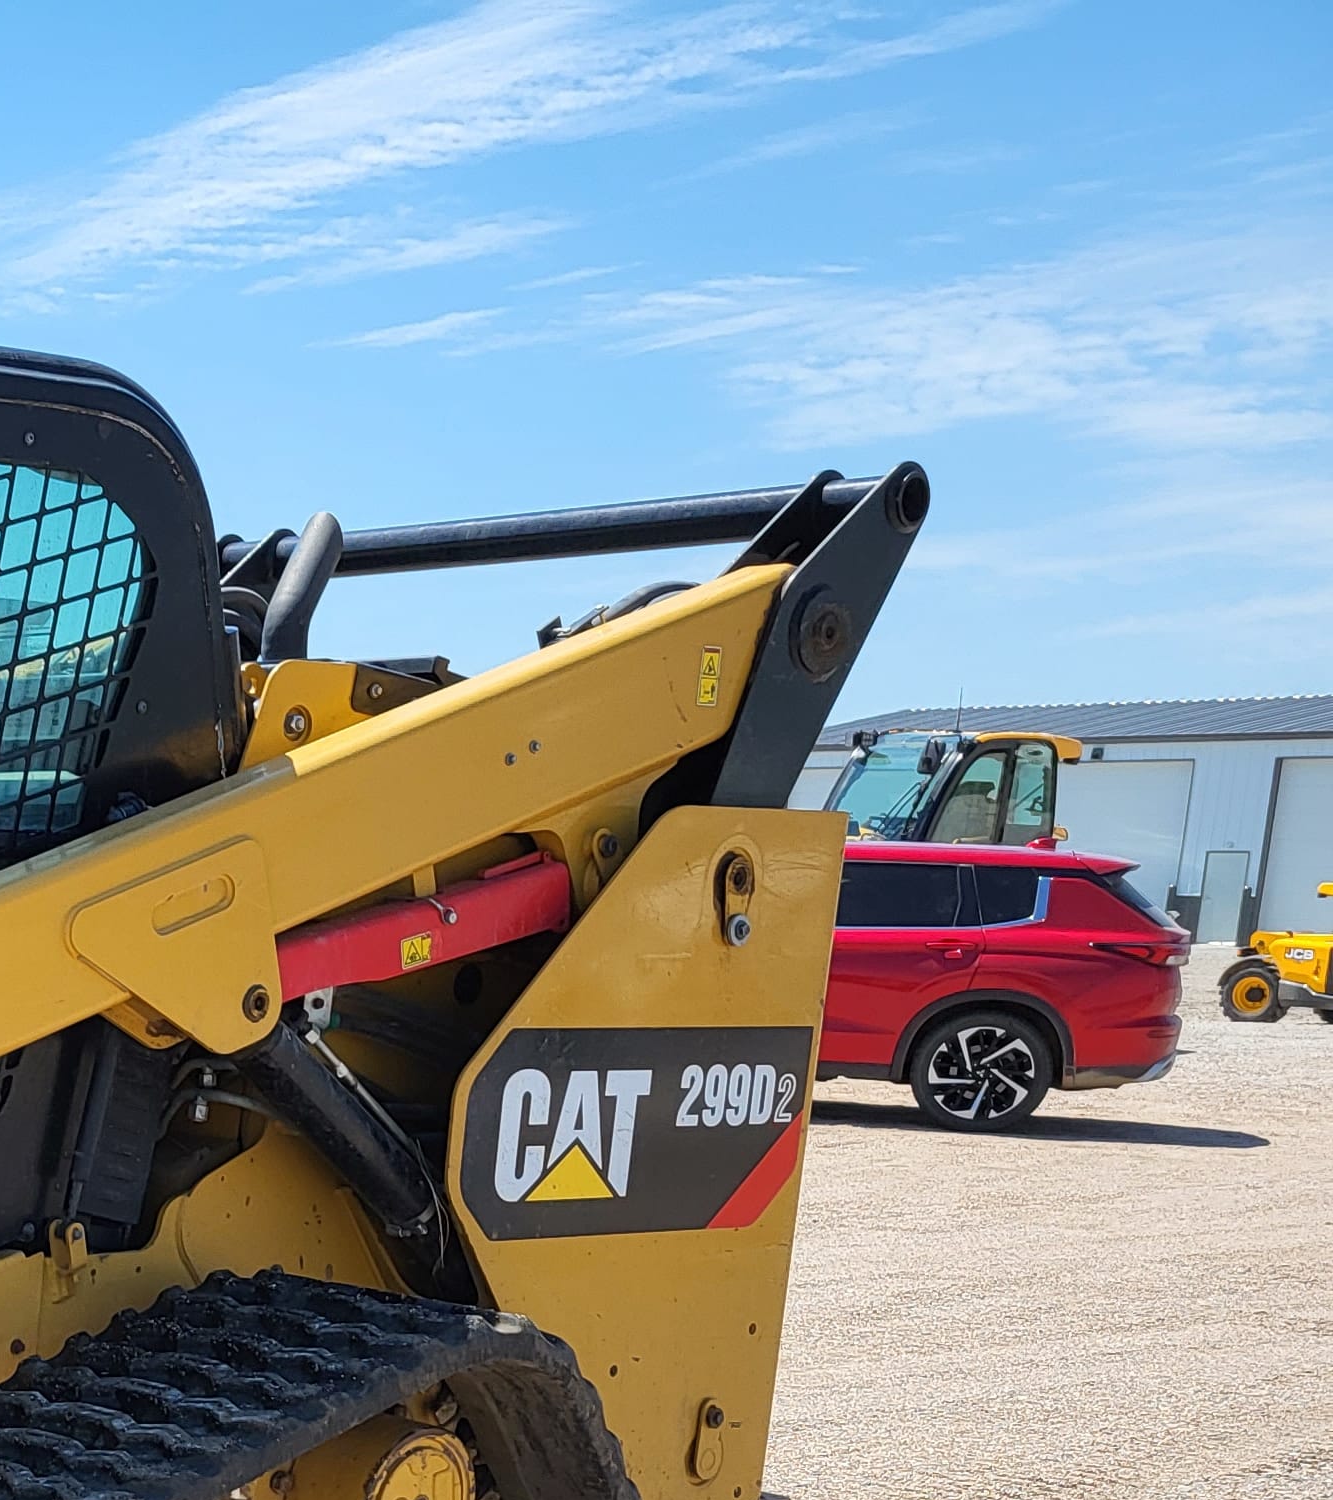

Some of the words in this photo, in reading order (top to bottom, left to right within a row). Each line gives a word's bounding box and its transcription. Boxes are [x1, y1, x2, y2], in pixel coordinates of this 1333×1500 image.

[1284, 947, 1315, 960] JCB
[494, 1068, 653, 1202] CAT
[675, 1063, 797, 1128] 299D2
